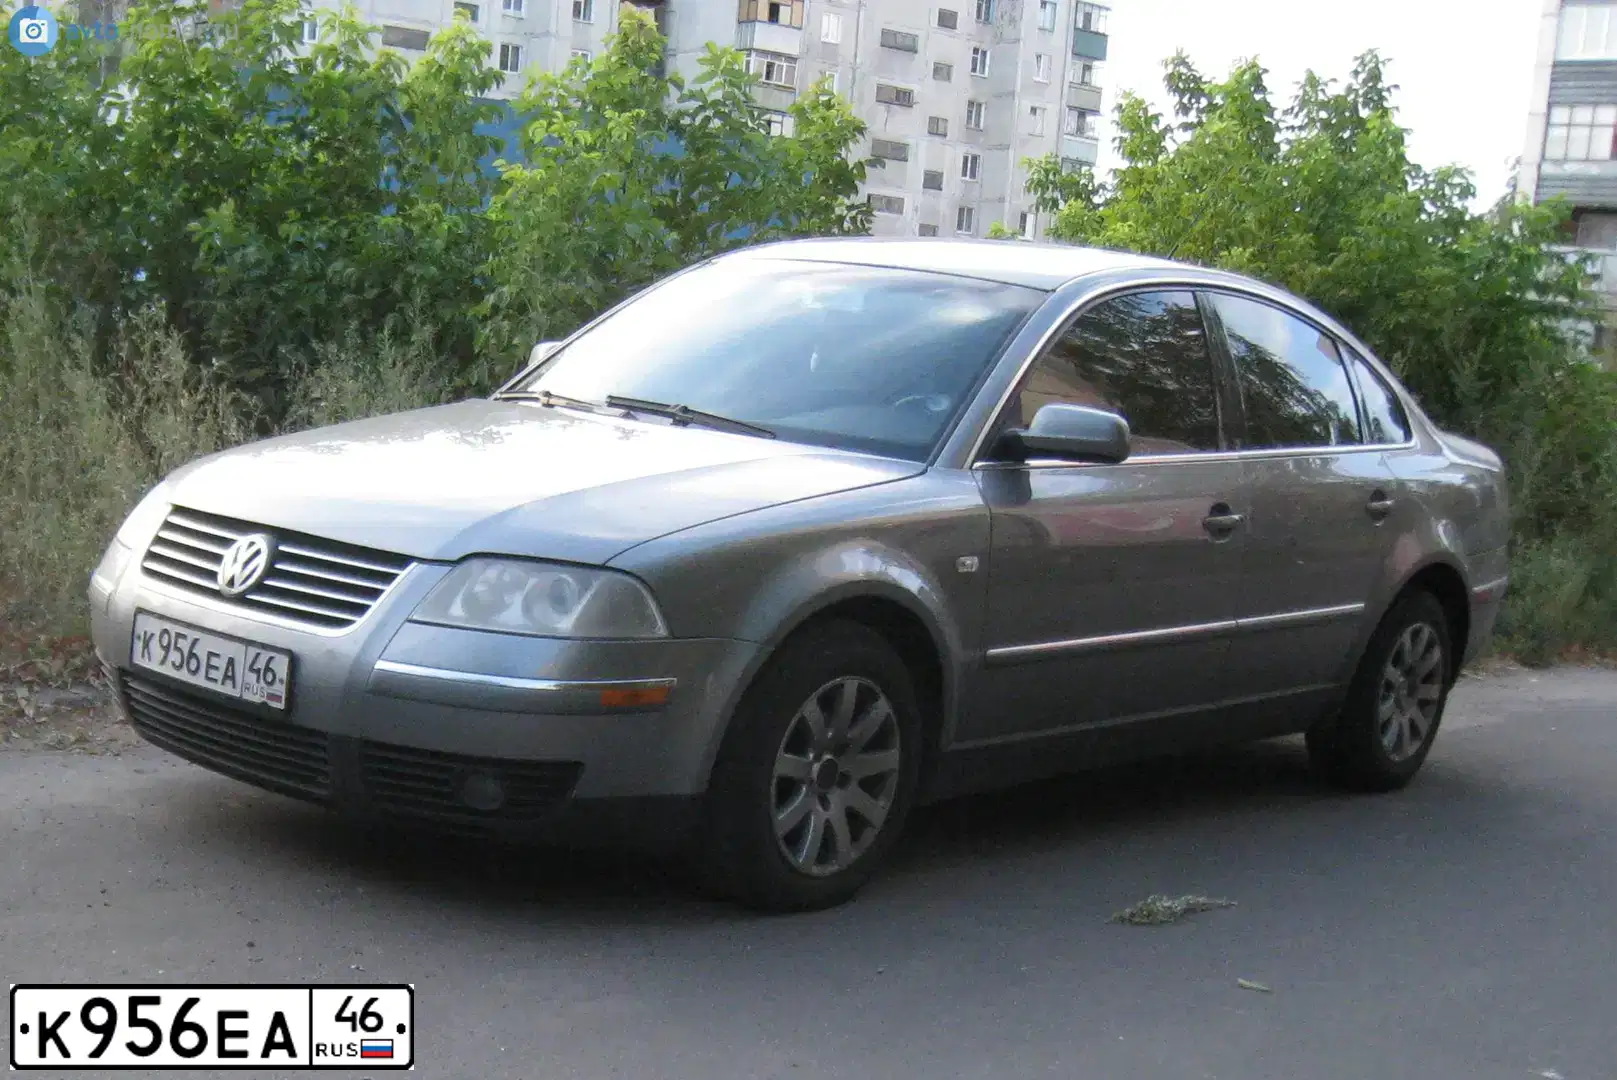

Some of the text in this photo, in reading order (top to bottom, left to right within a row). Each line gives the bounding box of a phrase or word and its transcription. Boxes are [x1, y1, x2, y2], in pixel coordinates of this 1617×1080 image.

[140, 628, 277, 689] K956EA 46
[244, 684, 266, 699] RUS
